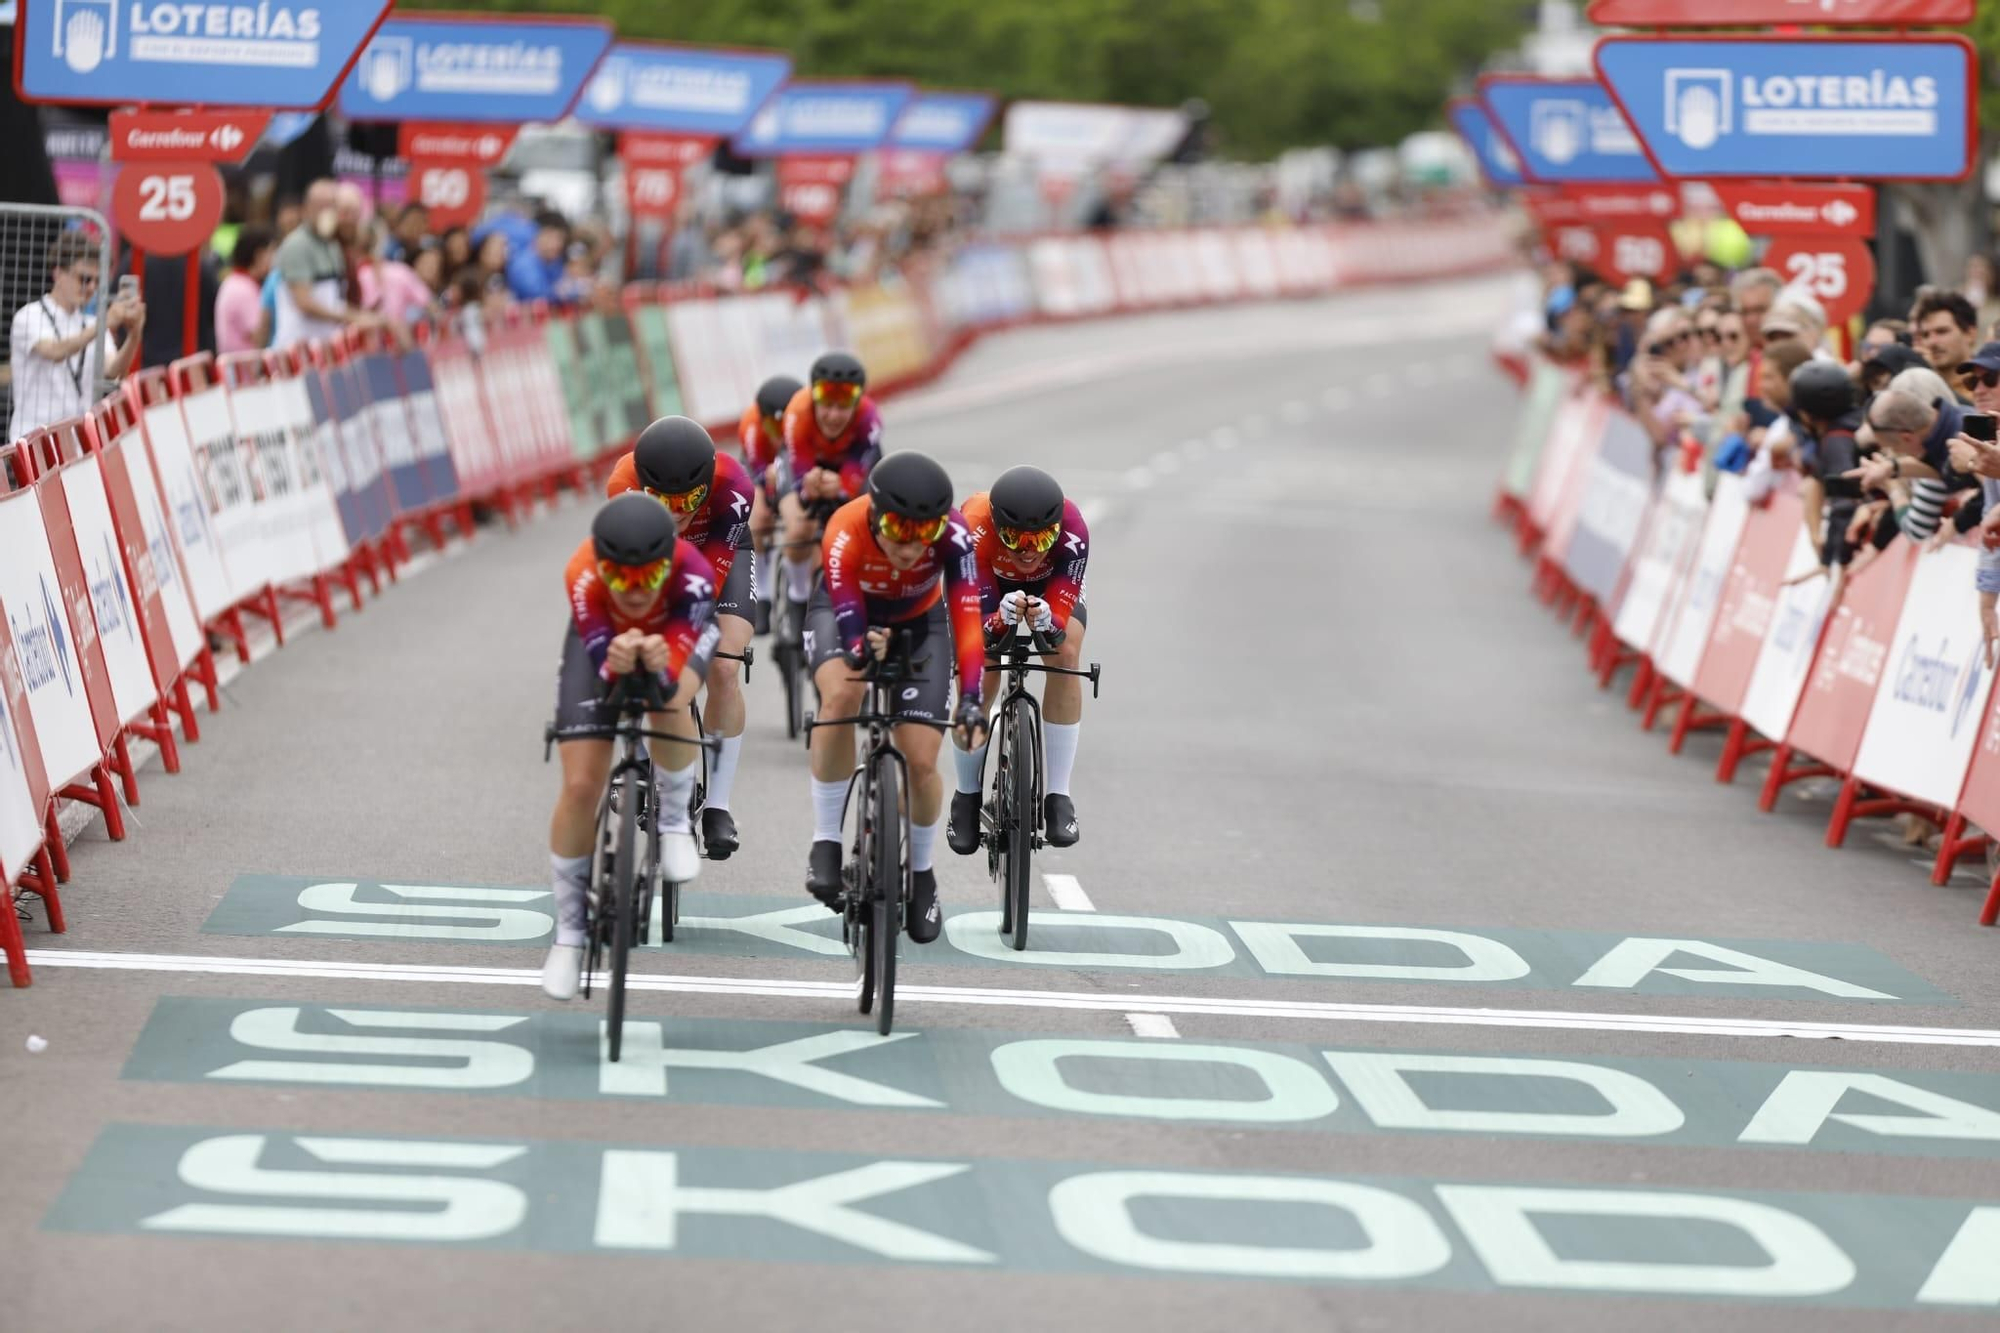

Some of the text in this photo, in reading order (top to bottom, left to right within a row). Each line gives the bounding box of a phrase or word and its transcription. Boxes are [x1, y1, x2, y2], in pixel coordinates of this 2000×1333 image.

[130, 1, 321, 39] LOTERÍAS
[1742, 68, 1938, 108] LOTERÍAS
[127, 129, 205, 149] Carrefour
[138, 175, 197, 221] 25
[1786, 252, 1848, 300] 25
[829, 530, 851, 590] THORNE
[276, 882, 1902, 1001] SKODA
[141, 1133, 2000, 1308] SKOD
